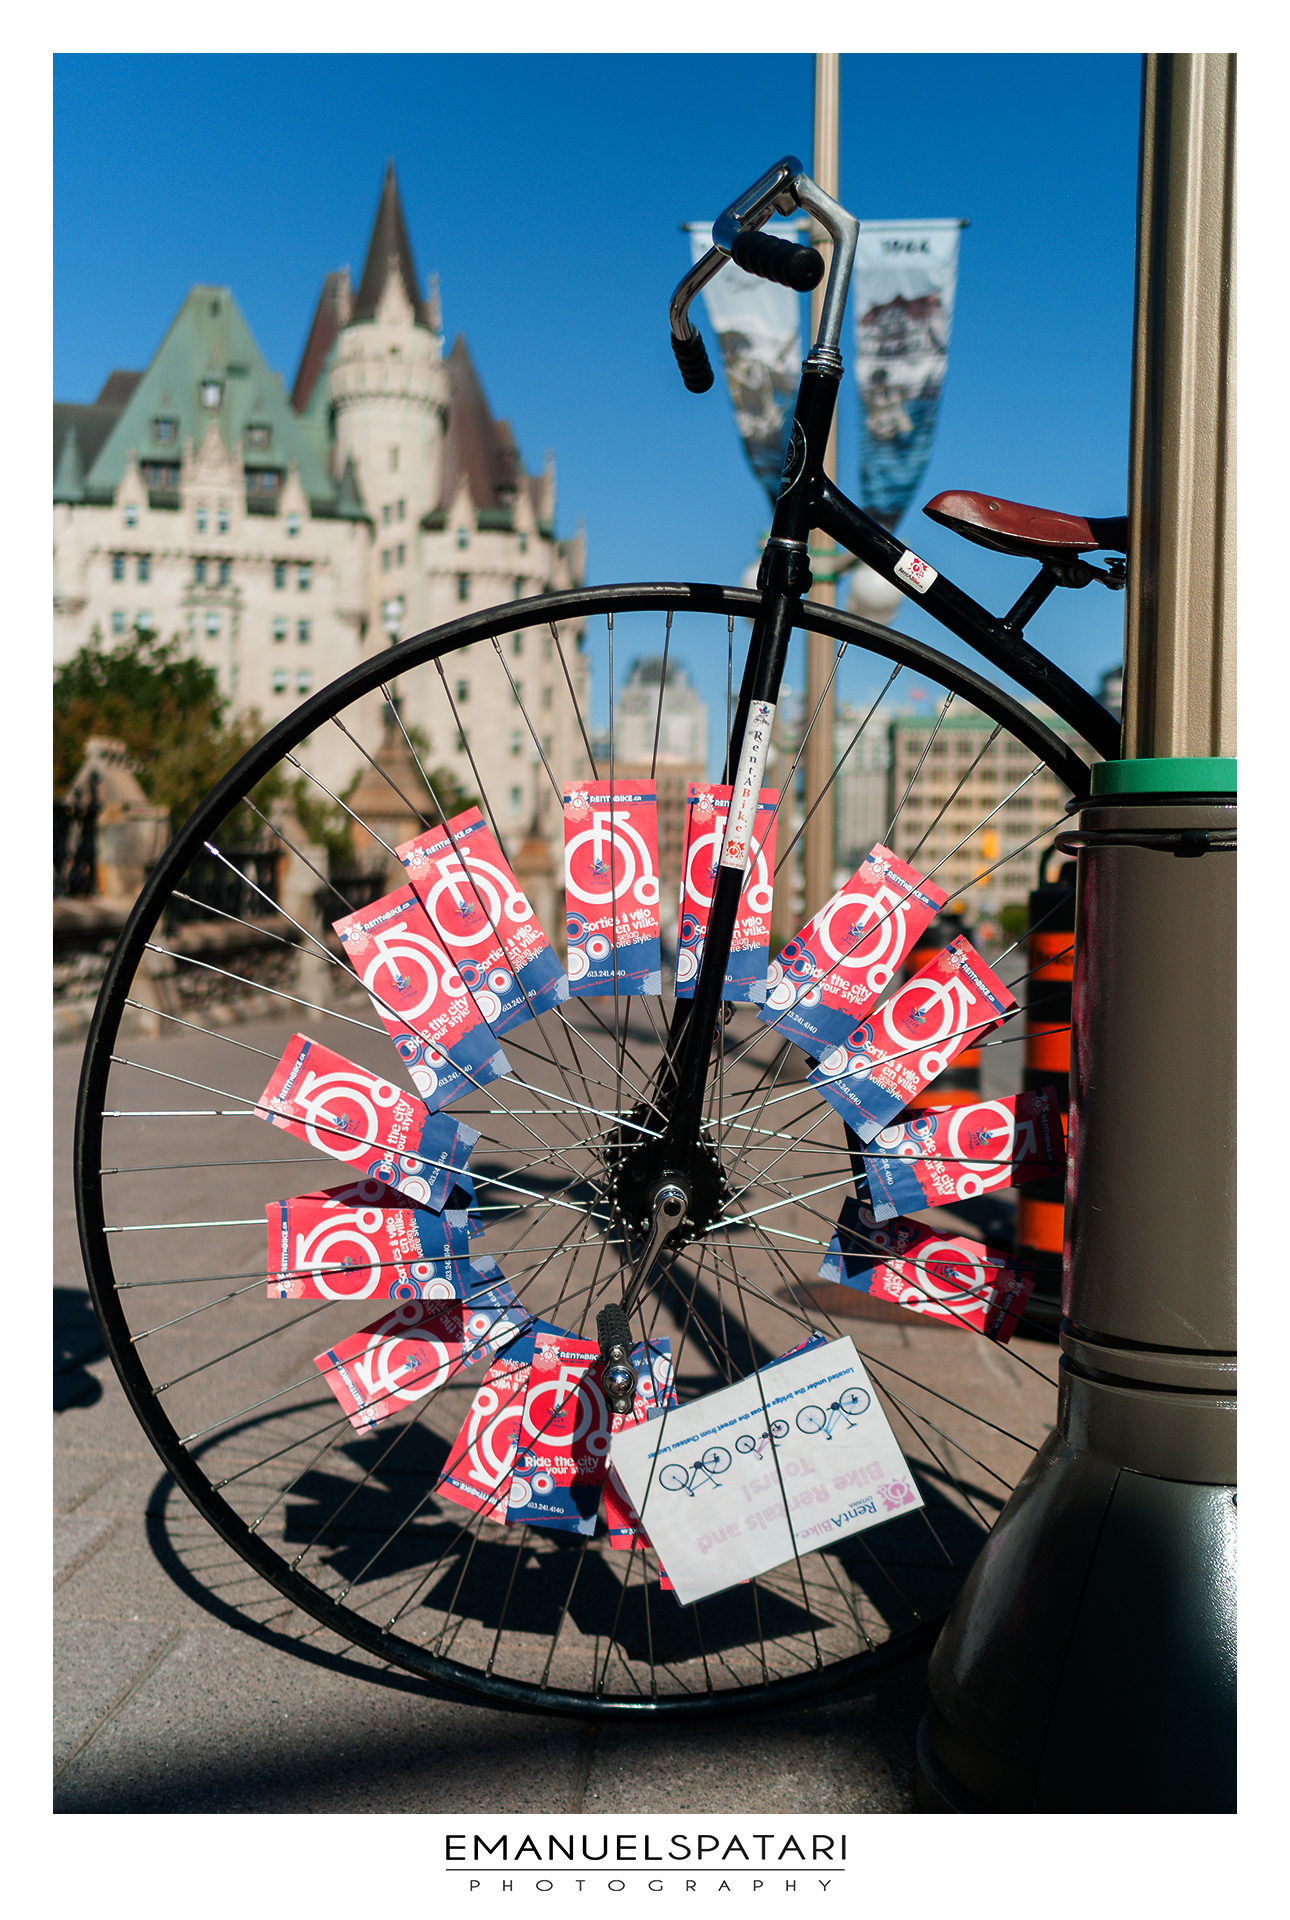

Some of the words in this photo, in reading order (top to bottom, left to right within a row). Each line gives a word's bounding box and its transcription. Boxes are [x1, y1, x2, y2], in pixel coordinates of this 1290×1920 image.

[582, 916, 620, 932] Sorties
[615, 923, 630, 934] en
[733, 930, 741, 938] n
[633, 933, 652, 944] style
[818, 981, 841, 995] your
[841, 990, 864, 1005] style
[831, 974, 850, 990] the
[852, 984, 872, 1001] city
[428, 1013, 449, 1031] the
[448, 996, 469, 1016] city
[788, 1010, 817, 1034] 13.241.4140
[428, 1025, 448, 1045] your
[448, 1007, 470, 1028] style
[862, 1040, 895, 1067] Sortis
[882, 1066, 896, 1080] en
[393, 1098, 410, 1120] city
[402, 1107, 414, 1132] style
[386, 1124, 401, 1145] the
[398, 1133, 407, 1151] our
[380, 1150, 395, 1174] Rid
[918, 1126, 936, 1153] Ride
[942, 1174, 956, 1196] city
[920, 1150, 934, 1170] yur
[931, 1171, 946, 1195] style
[399, 1238, 409, 1253] en
[392, 1248, 408, 1284] Sortes
[887, 1276, 904, 1298] city
[440, 1314, 457, 1334] the
[807, 1378, 827, 1390] under
[827, 1367, 854, 1382] Located
[751, 1403, 771, 1416] aross
[772, 1393, 794, 1405] bridge
[700, 1427, 717, 1437] from
[717, 1418, 737, 1431] street
[672, 1435, 700, 1448] Chateau
[524, 1456, 552, 1467] Ride
[554, 1456, 575, 1467] the
[577, 1455, 600, 1468] city
[546, 1467, 568, 1475] your
[570, 1466, 595, 1476] style
[741, 1457, 816, 1501] Tours!
[833, 1461, 885, 1490] Bike
[745, 1484, 831, 1531] Rentals
[795, 1502, 877, 1539] RentABike.c
[696, 1522, 741, 1555] and
